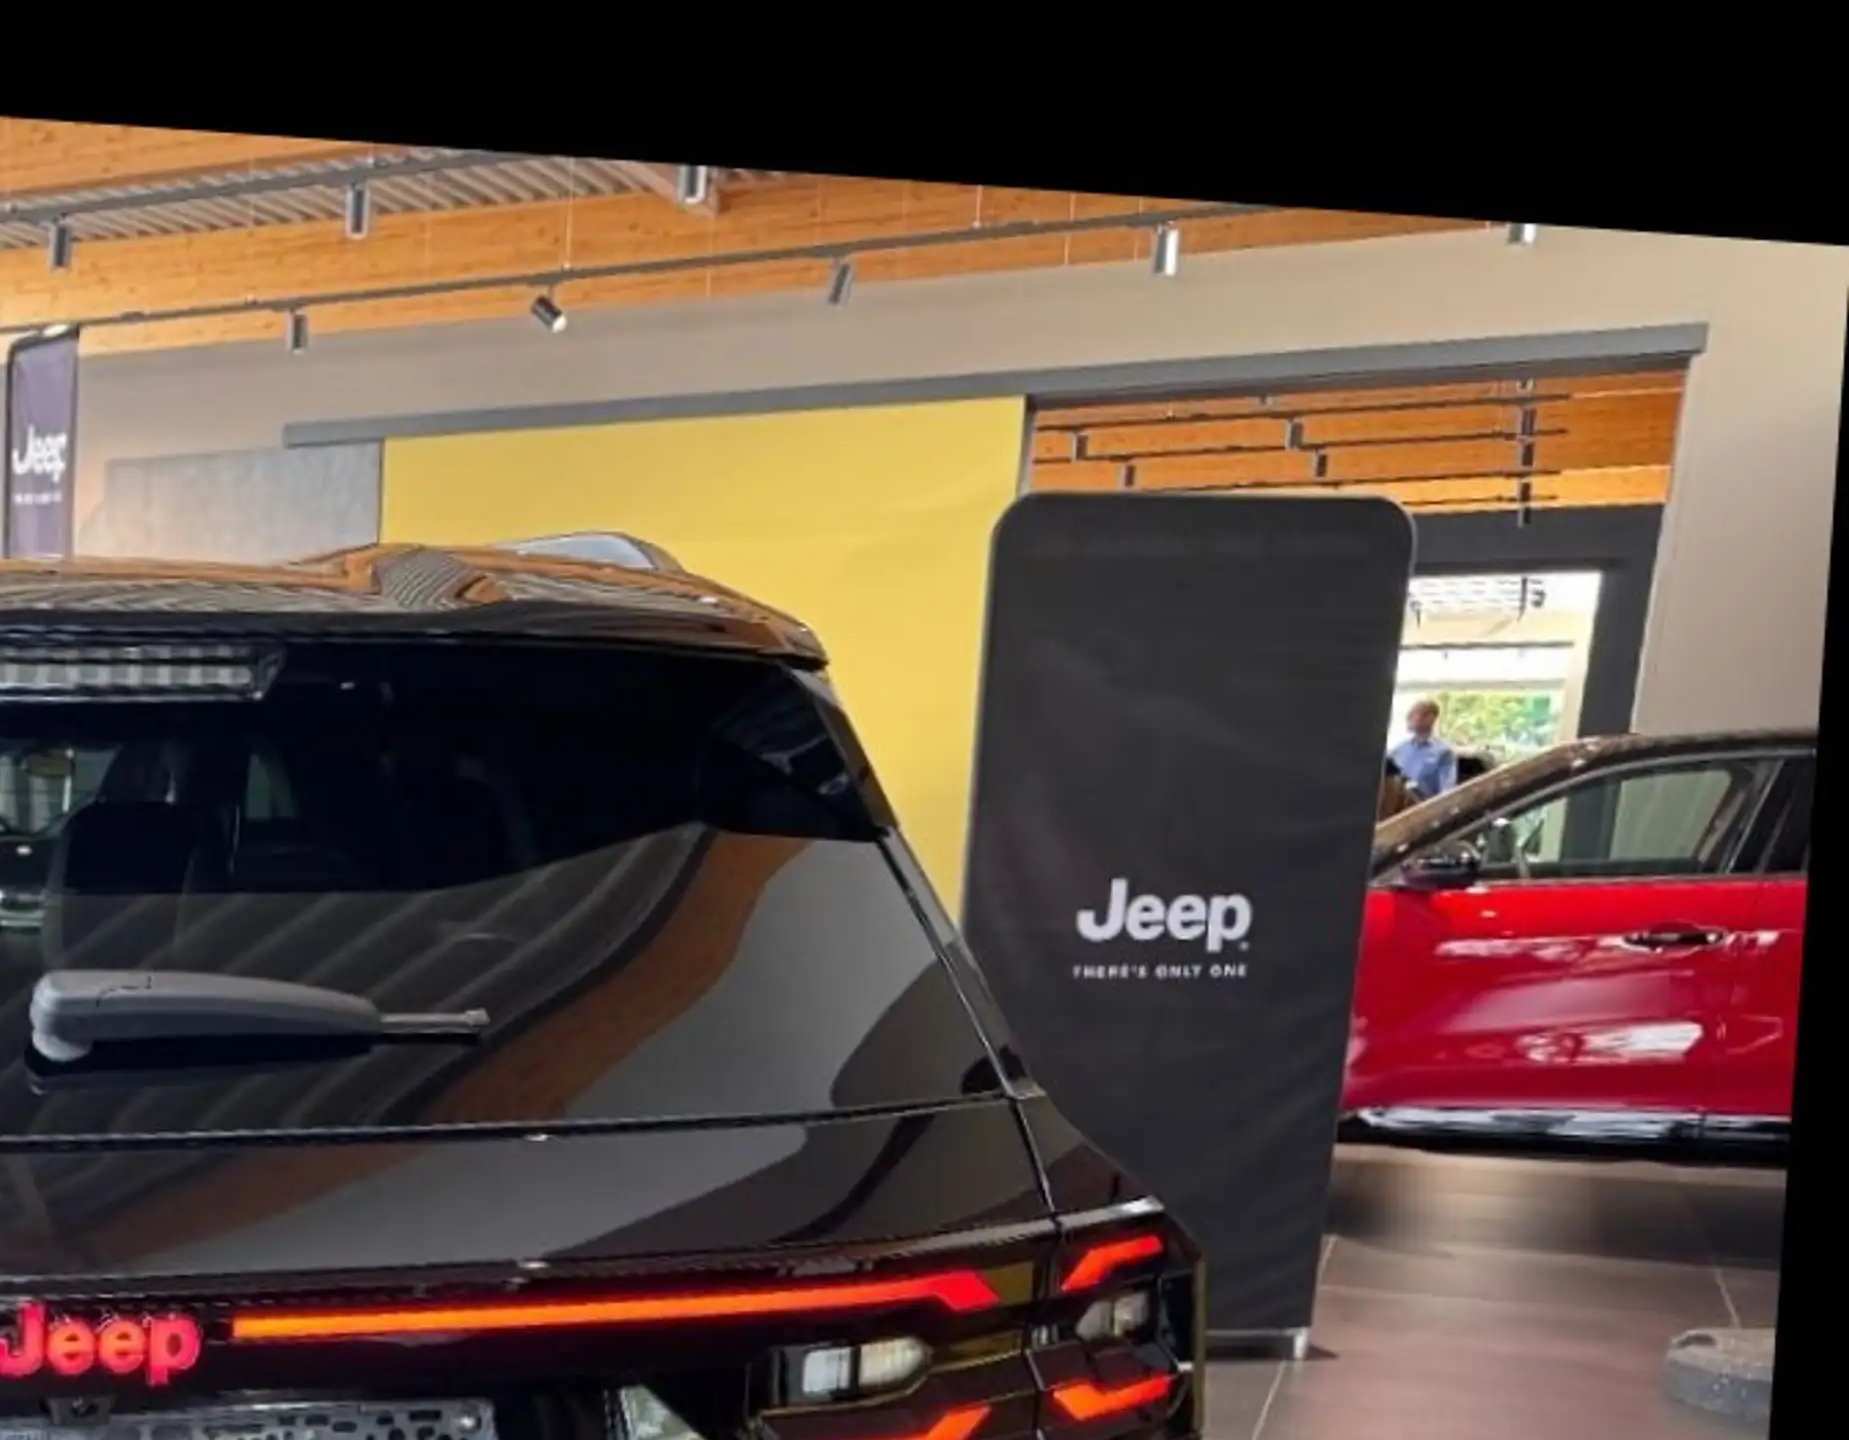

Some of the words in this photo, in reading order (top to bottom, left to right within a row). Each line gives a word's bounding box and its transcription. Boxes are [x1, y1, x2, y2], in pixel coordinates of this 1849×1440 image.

[1076, 877, 1252, 953] Jeep
[1072, 963, 1148, 979] THERE'S
[1155, 963, 1202, 979] ONLY
[1209, 962, 1248, 978] ONE
